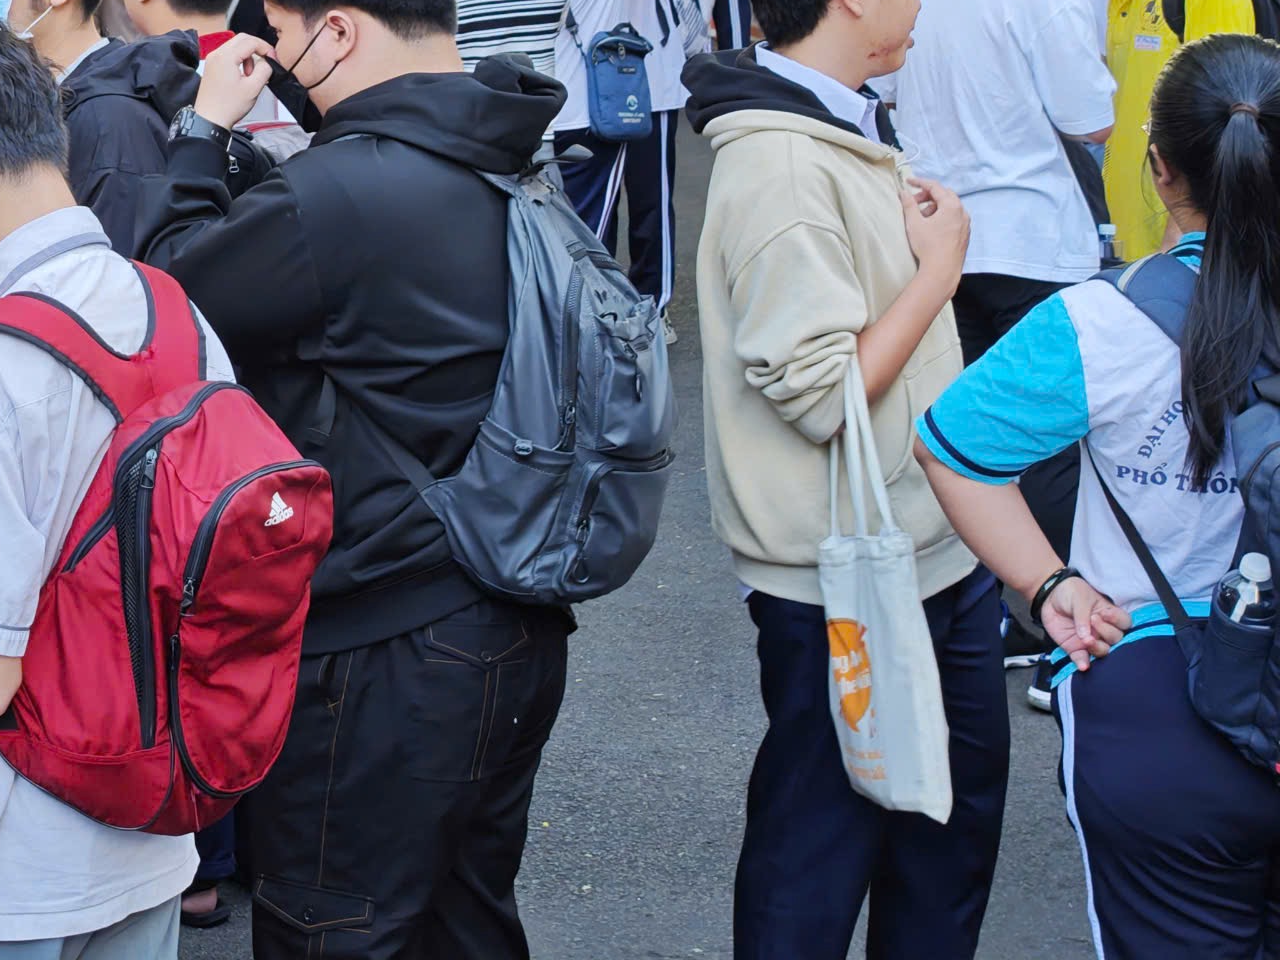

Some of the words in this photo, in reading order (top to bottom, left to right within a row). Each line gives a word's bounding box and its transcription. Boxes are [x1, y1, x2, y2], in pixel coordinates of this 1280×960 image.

[1116, 462, 1168, 486] PHỔ
[1175, 471, 1240, 494] THÔN
[264, 506, 294, 527] adidas
